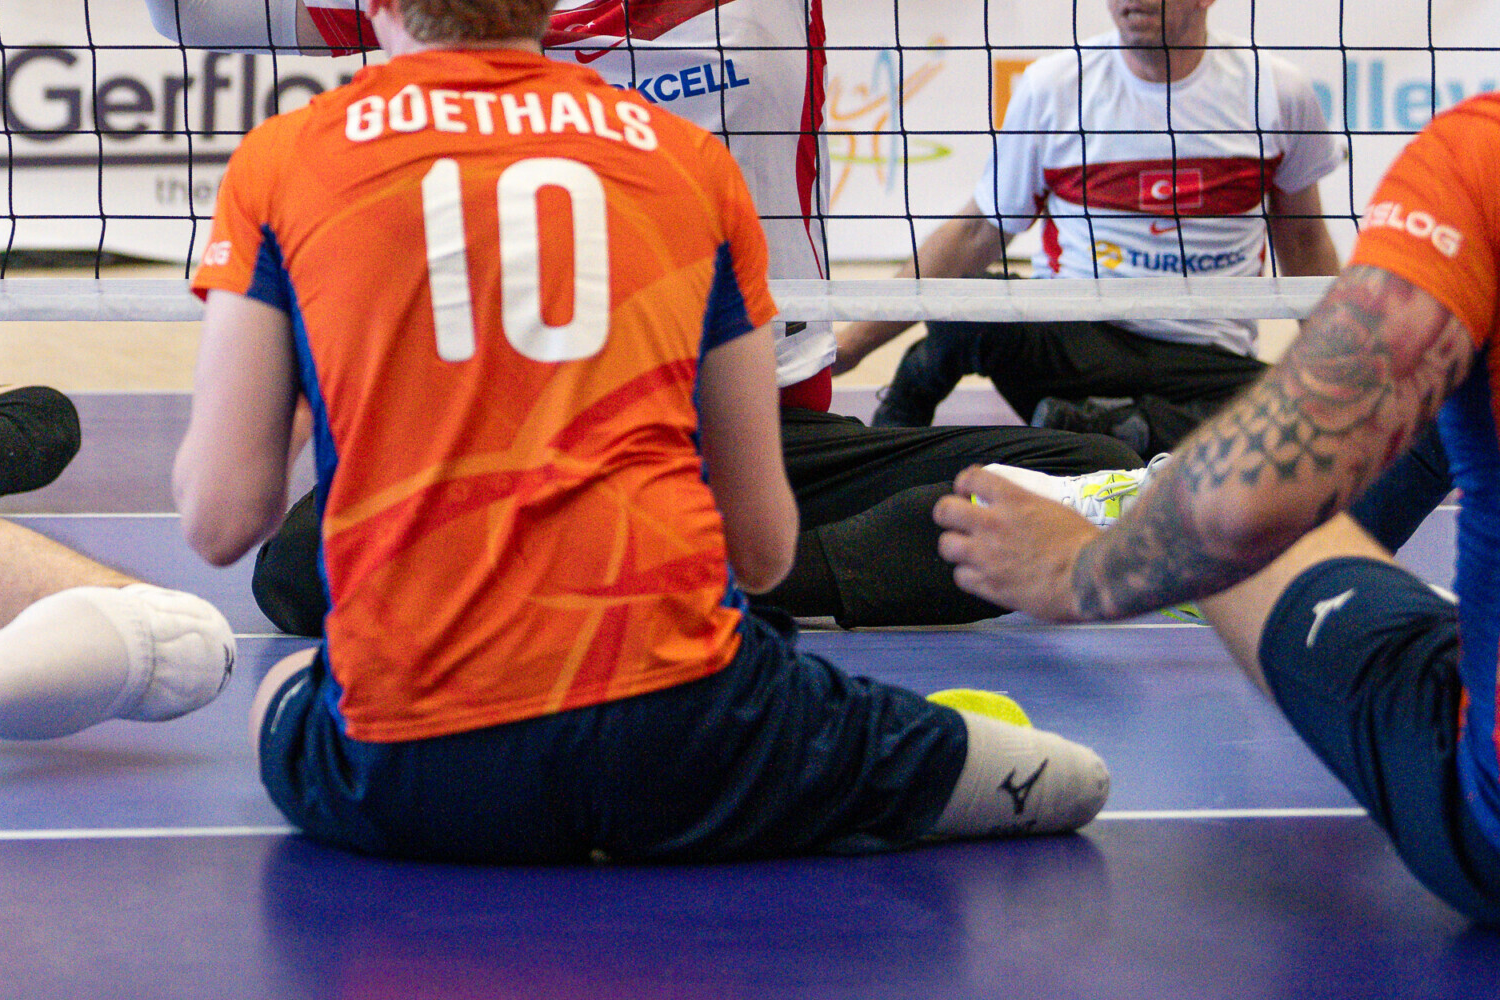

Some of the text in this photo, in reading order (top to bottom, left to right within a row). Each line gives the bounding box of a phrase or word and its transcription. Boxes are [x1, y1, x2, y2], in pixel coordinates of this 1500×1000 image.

[612, 59, 750, 104] KCELL
[345, 85, 658, 151] GOETHALS
[421, 157, 611, 363] 10
